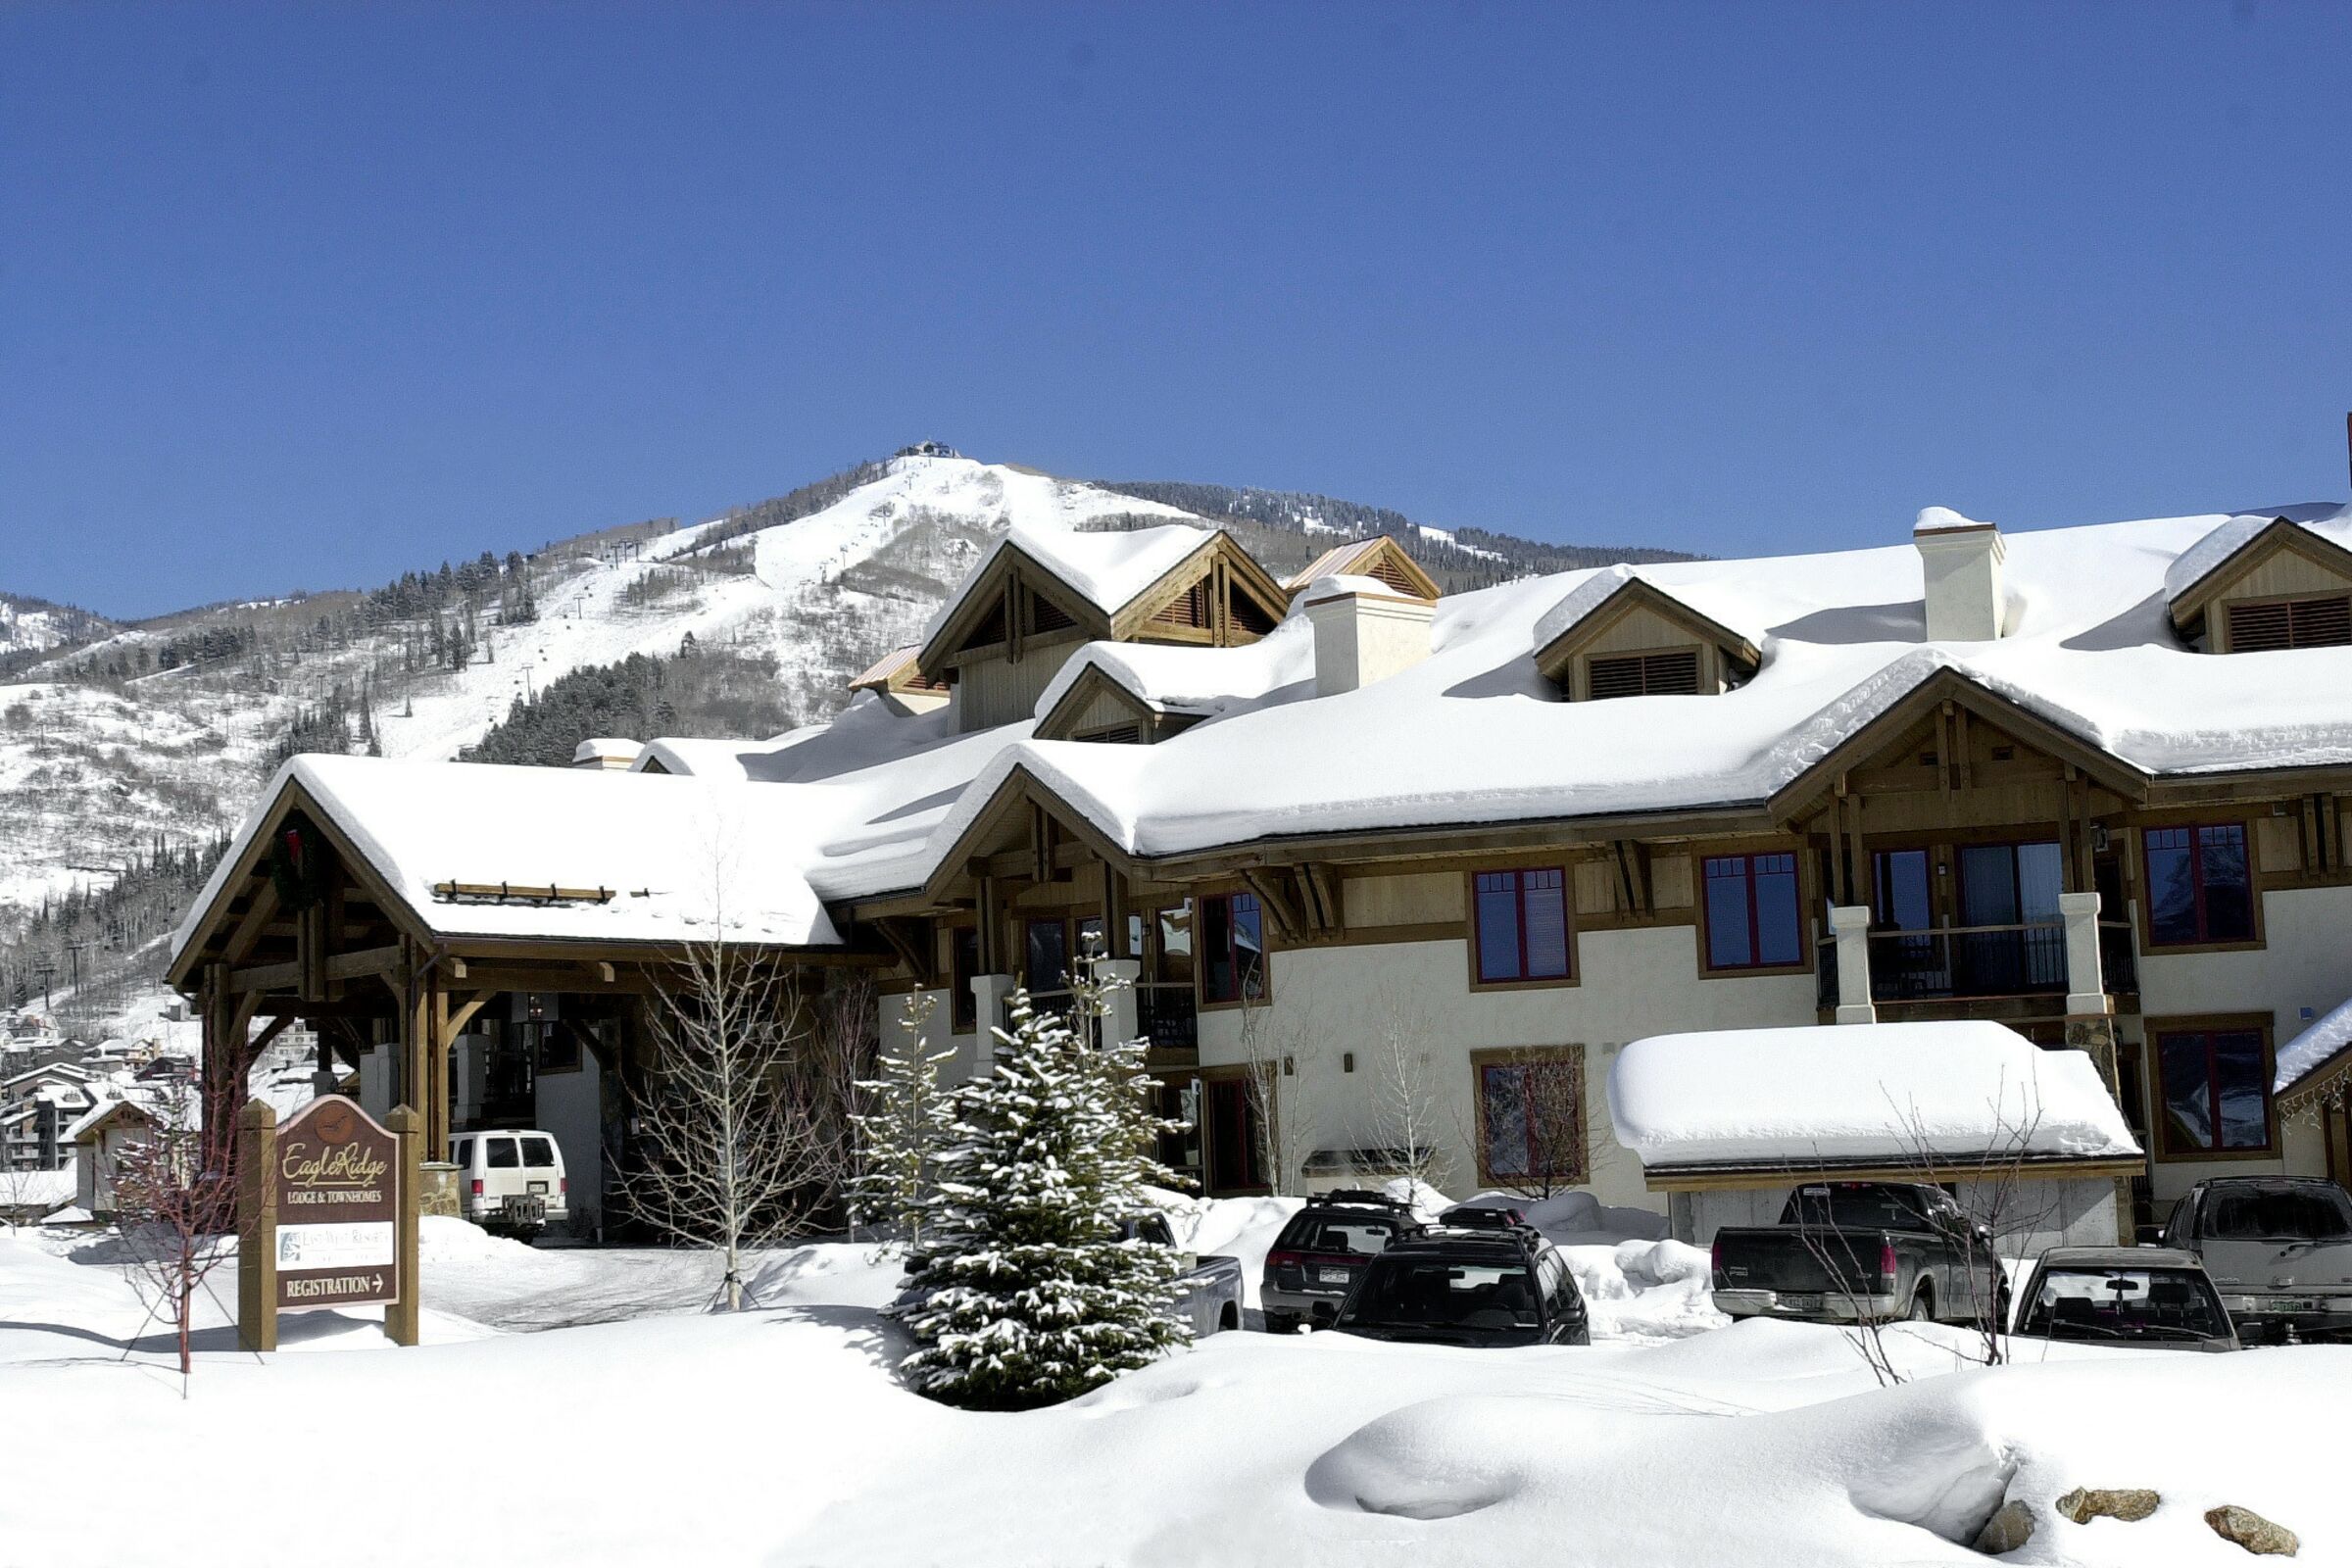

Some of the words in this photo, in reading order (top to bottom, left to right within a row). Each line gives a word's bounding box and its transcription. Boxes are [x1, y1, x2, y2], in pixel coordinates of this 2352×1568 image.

[287, 1191, 316, 1204] LODGE
[318, 1192, 326, 1203] &
[327, 1190, 382, 1203] TOWNHOMES
[286, 1276, 370, 1298] REGISTRATION
